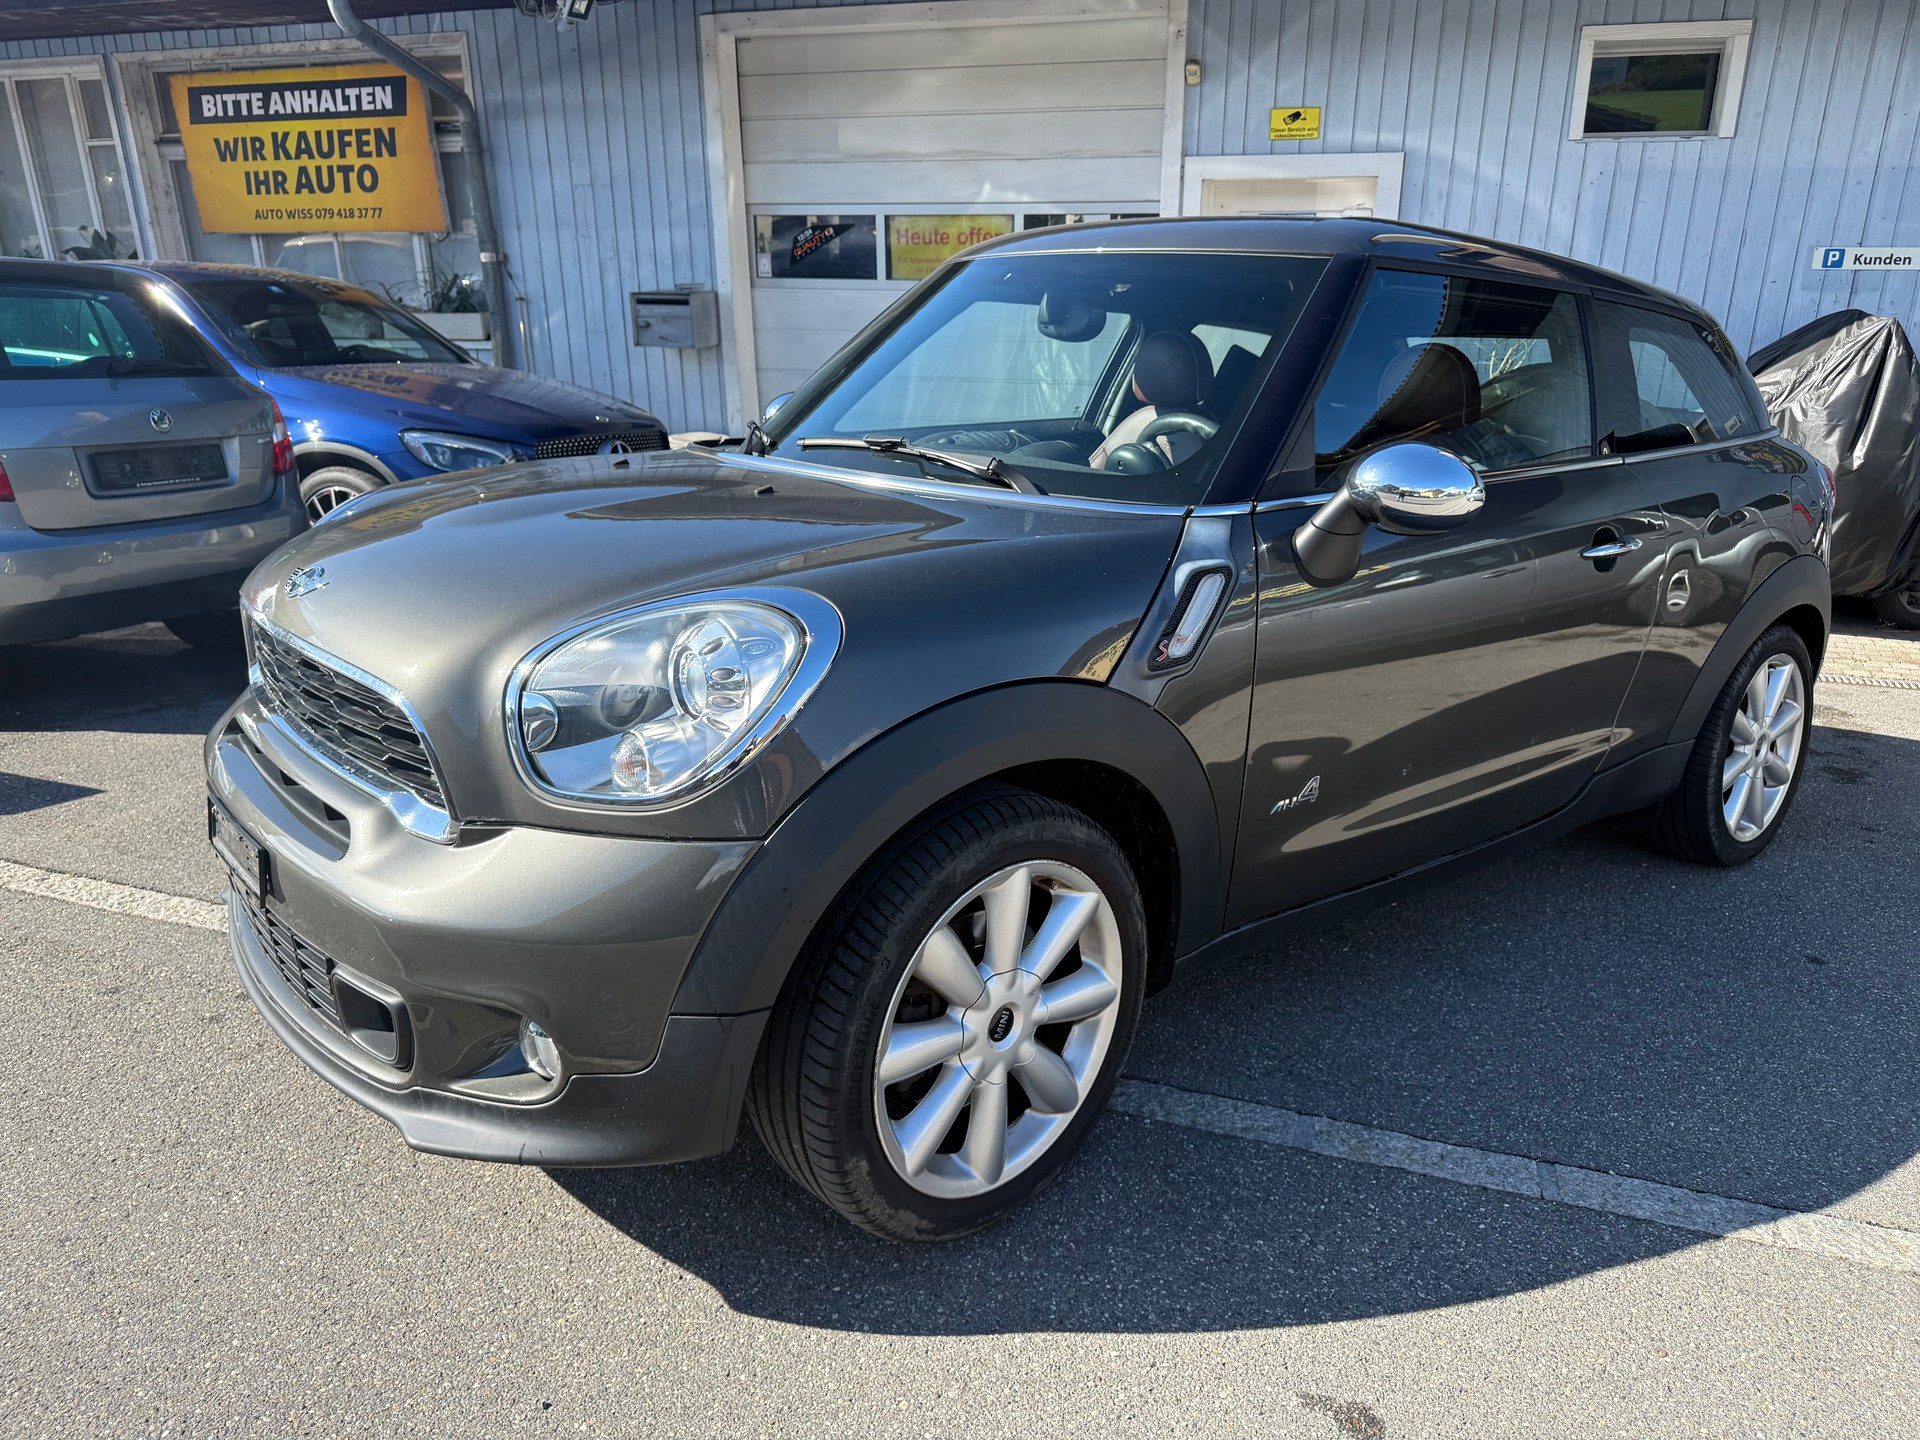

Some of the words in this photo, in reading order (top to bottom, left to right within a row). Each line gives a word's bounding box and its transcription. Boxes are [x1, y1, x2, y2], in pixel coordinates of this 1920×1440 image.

[201, 92, 265, 118] BITTE
[268, 85, 394, 115] ANHALTEN
[213, 136, 267, 163] WIR
[271, 127, 398, 160] KAUFEN
[244, 170, 290, 195] IHR
[294, 163, 379, 194] AUTO
[254, 208, 283, 220] AUTO
[285, 208, 314, 219] WISS
[315, 208, 335, 219] 079
[336, 207, 355, 219] 418
[357, 207, 370, 218] 37
[370, 207, 383, 218] 77
[896, 227, 950, 245] Heute
[1827, 251, 1840, 266] P
[1852, 253, 1912, 266] Kunden
[1156, 639, 1168, 662] S
[994, 1010, 1010, 1039] MINI
